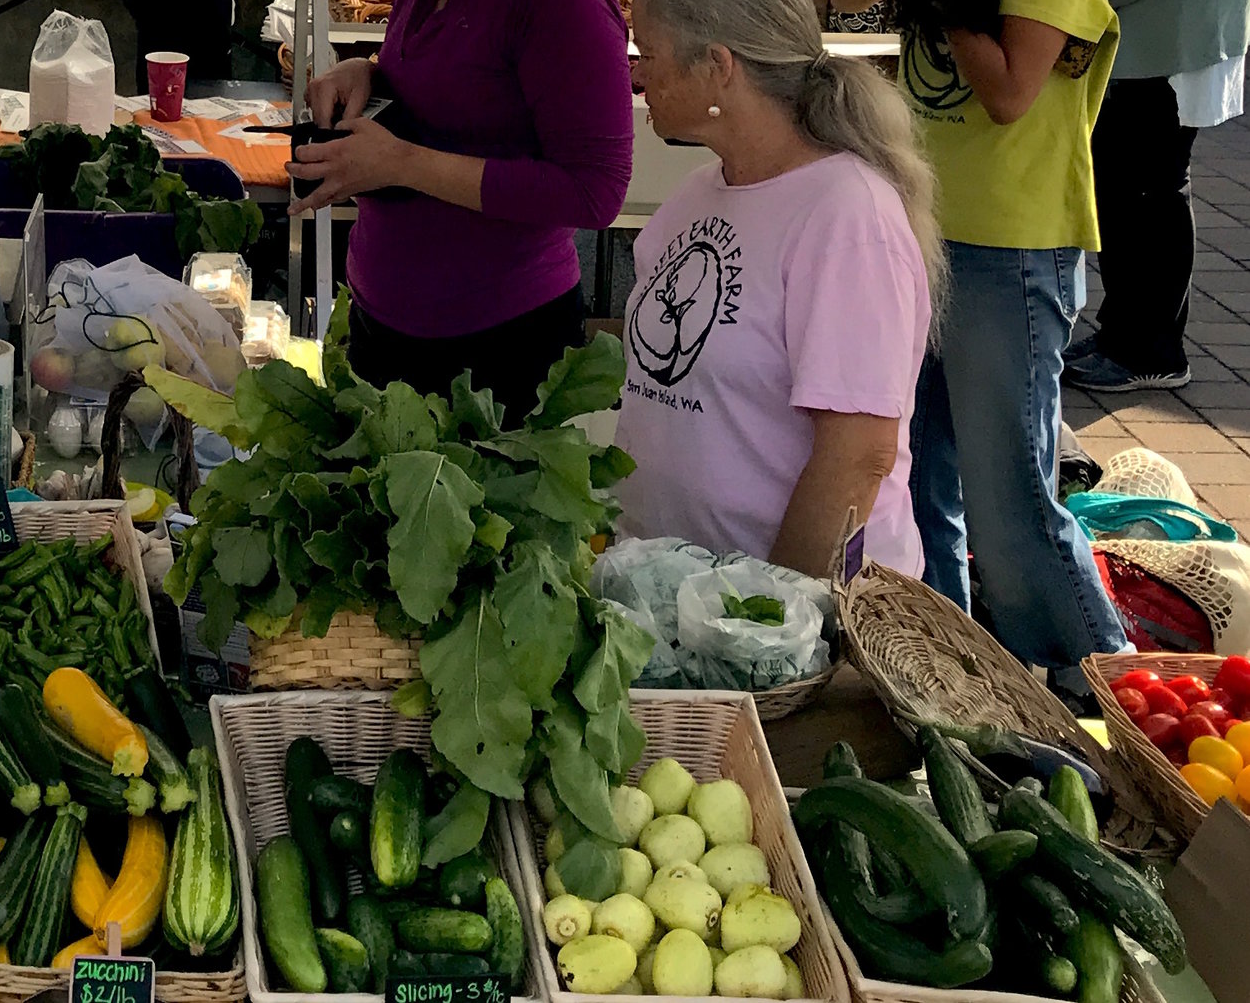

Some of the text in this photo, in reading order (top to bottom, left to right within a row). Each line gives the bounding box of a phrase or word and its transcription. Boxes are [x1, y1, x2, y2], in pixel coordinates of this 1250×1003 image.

[688, 216, 737, 245] EARTH
[718, 246, 743, 326] FARM
[681, 396, 704, 413] WA
